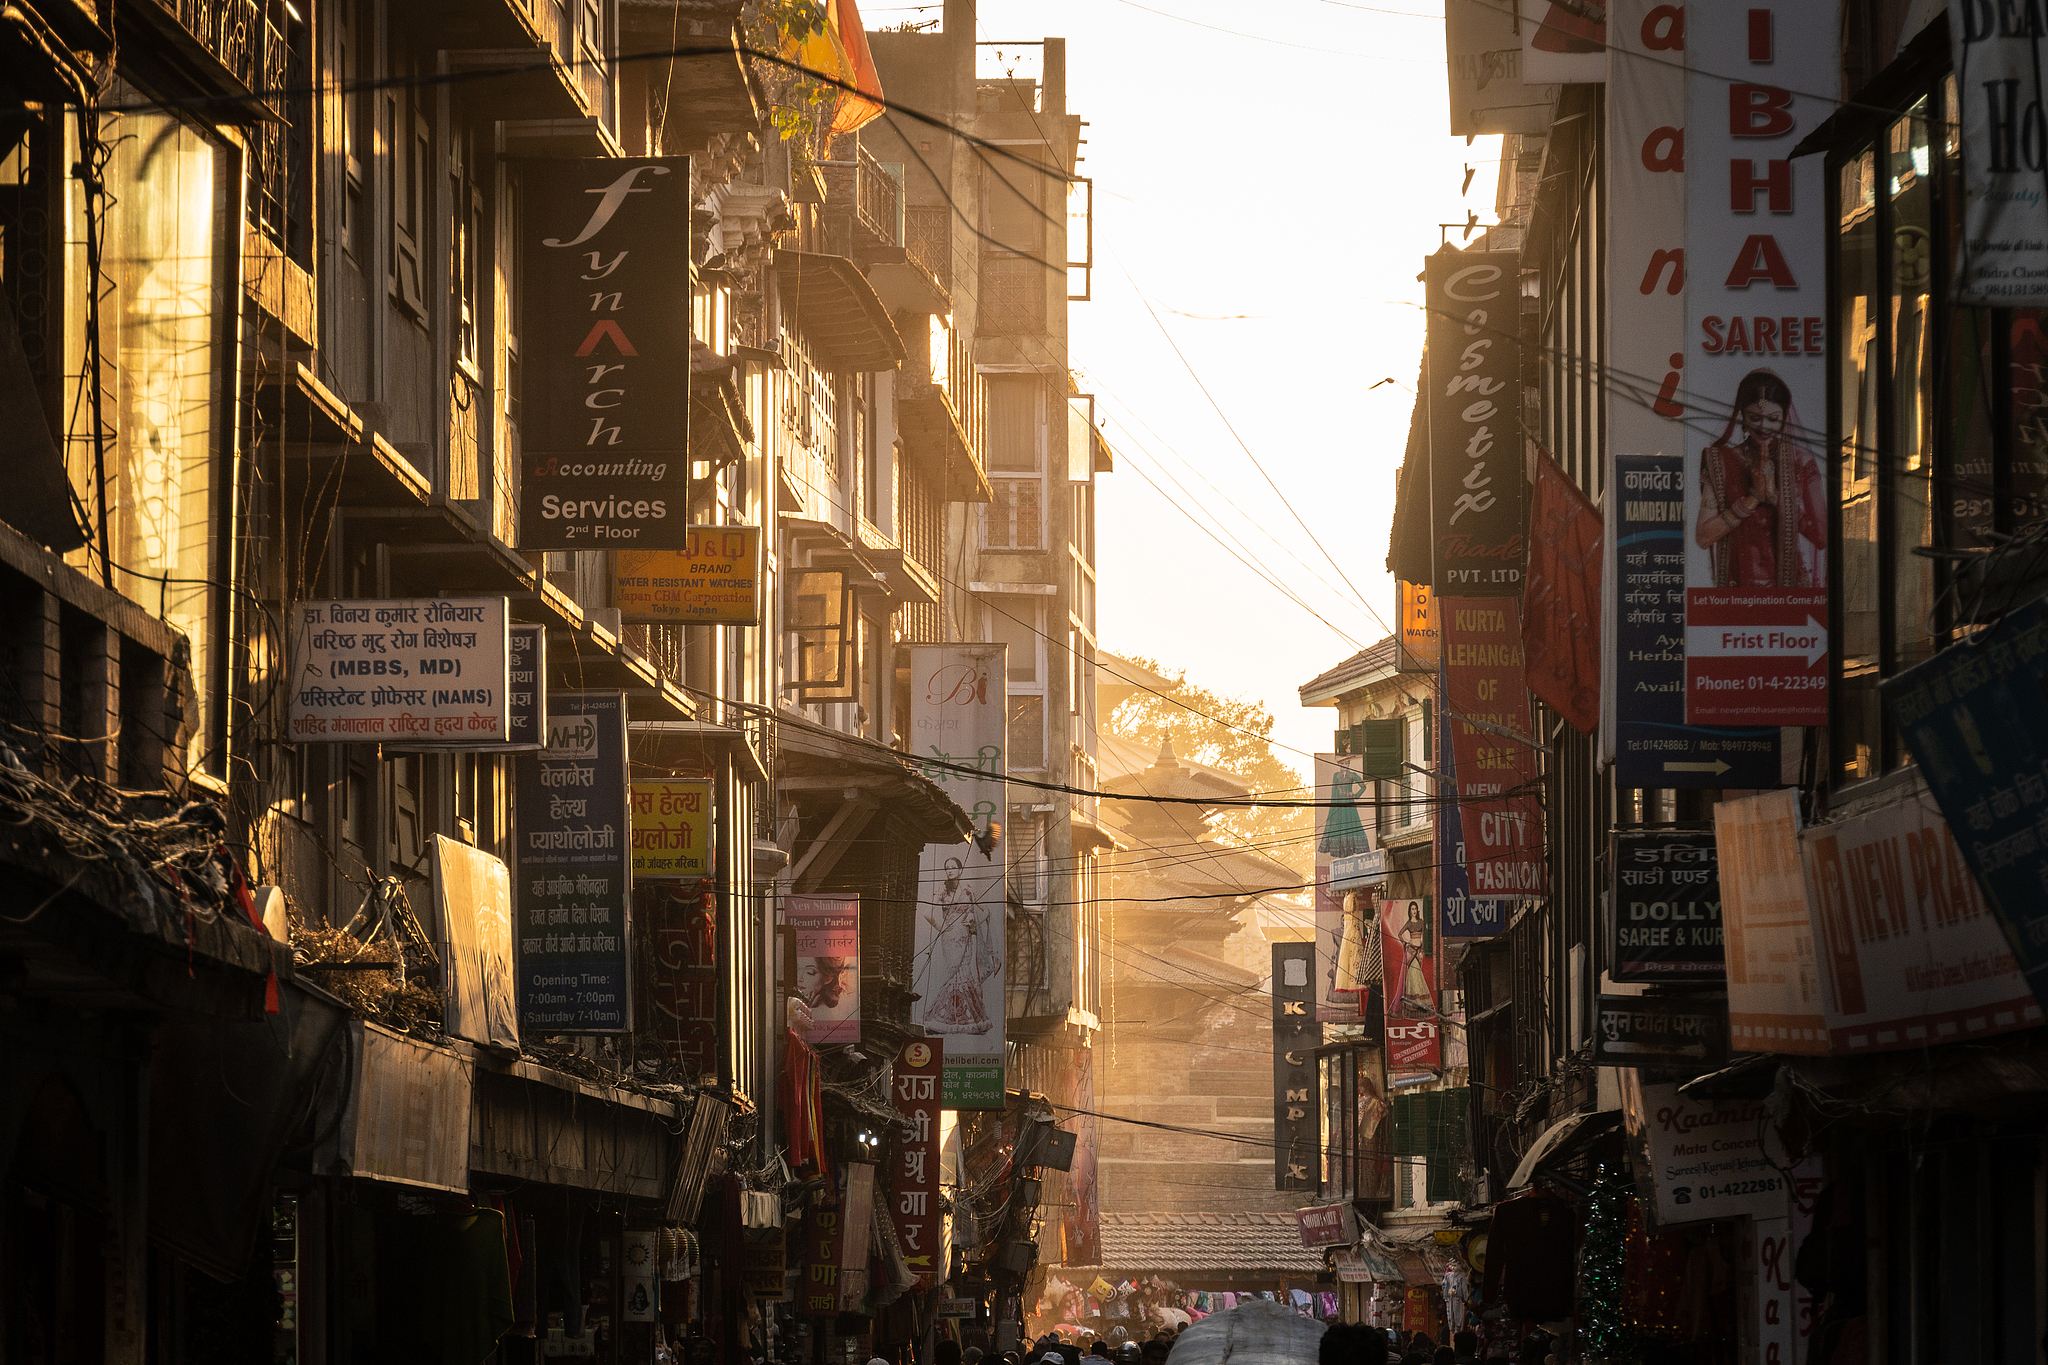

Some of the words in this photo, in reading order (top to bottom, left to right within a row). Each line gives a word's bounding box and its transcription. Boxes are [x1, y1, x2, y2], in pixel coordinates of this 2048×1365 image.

[1702, 315, 1824, 355] SAREE
[1443, 264, 1507, 526] Cosmetix
[534, 458, 668, 481] Accounting
[1625, 465, 1671, 491] कामदेव
[541, 495, 668, 520] Services
[1626, 502, 1667, 522] KAMDEV
[565, 524, 589, 539] 2nd
[594, 526, 640, 540] Floor
[690, 564, 732, 574] BRAND
[618, 578, 649, 588] WATER
[652, 578, 705, 588] RESISTANT
[709, 579, 752, 589] WATCHES
[652, 604, 681, 615] Tokyo
[686, 604, 718, 616] Japan
[1694, 595, 1708, 606] Let
[1709, 595, 1729, 606] Your
[1731, 595, 1785, 608] Imagination
[1786, 595, 1812, 606] Come
[330, 604, 370, 624] विनय
[375, 605, 419, 627] कुमार
[424, 601, 485, 624] रौनियार
[1456, 609, 1506, 633] KURTA
[313, 629, 356, 650] वरिष्ठ
[362, 632, 387, 653] मुटु
[391, 629, 418, 650] रोग
[423, 629, 477, 650] विशेषज्ञ
[1406, 629, 1438, 638] WATCH
[1722, 632, 1764, 649] Frist
[1768, 632, 1818, 649] Floor
[1448, 645, 1521, 666] LEHANGA
[330, 659, 409, 679] (MBBS,
[420, 657, 461, 677] MD)
[1478, 679, 1498, 701] OF
[1696, 676, 1744, 690] Phone:
[371, 686, 427, 708] प्रोफेसर
[432, 689, 492, 708] (NAMS)
[293, 714, 327, 735] शहिद
[331, 715, 384, 734] गंगालाल
[468, 712, 498, 733] केन्द्र
[1476, 747, 1515, 769] SALE
[540, 762, 595, 787] वेलनेस
[1466, 782, 1502, 797] NEW
[550, 794, 587, 819] हेल्थ
[660, 786, 702, 816] हेल्थ
[1480, 812, 1527, 846] CITY
[1475, 861, 1541, 890] FASHION
[1621, 866, 1665, 886] साडी
[1630, 902, 1722, 921] DOLLY
[790, 917, 820, 929] Beauty
[824, 917, 854, 927] Parlor
[1619, 927, 1670, 946] SAREE
[1675, 927, 1686, 946] &
[533, 974, 578, 989] Opening
[581, 973, 610, 986] Time:
[528, 993, 567, 1005] 7:00am
[576, 991, 616, 1006] 7:00pm
[524, 1011, 575, 1026] (Saturday
[578, 1009, 620, 1024] 7-10am)
[1601, 1010, 1633, 1041] सुन
[1387, 1021, 1439, 1040] परी
[913, 1045, 923, 1057] S
[898, 1075, 937, 1101] राज
